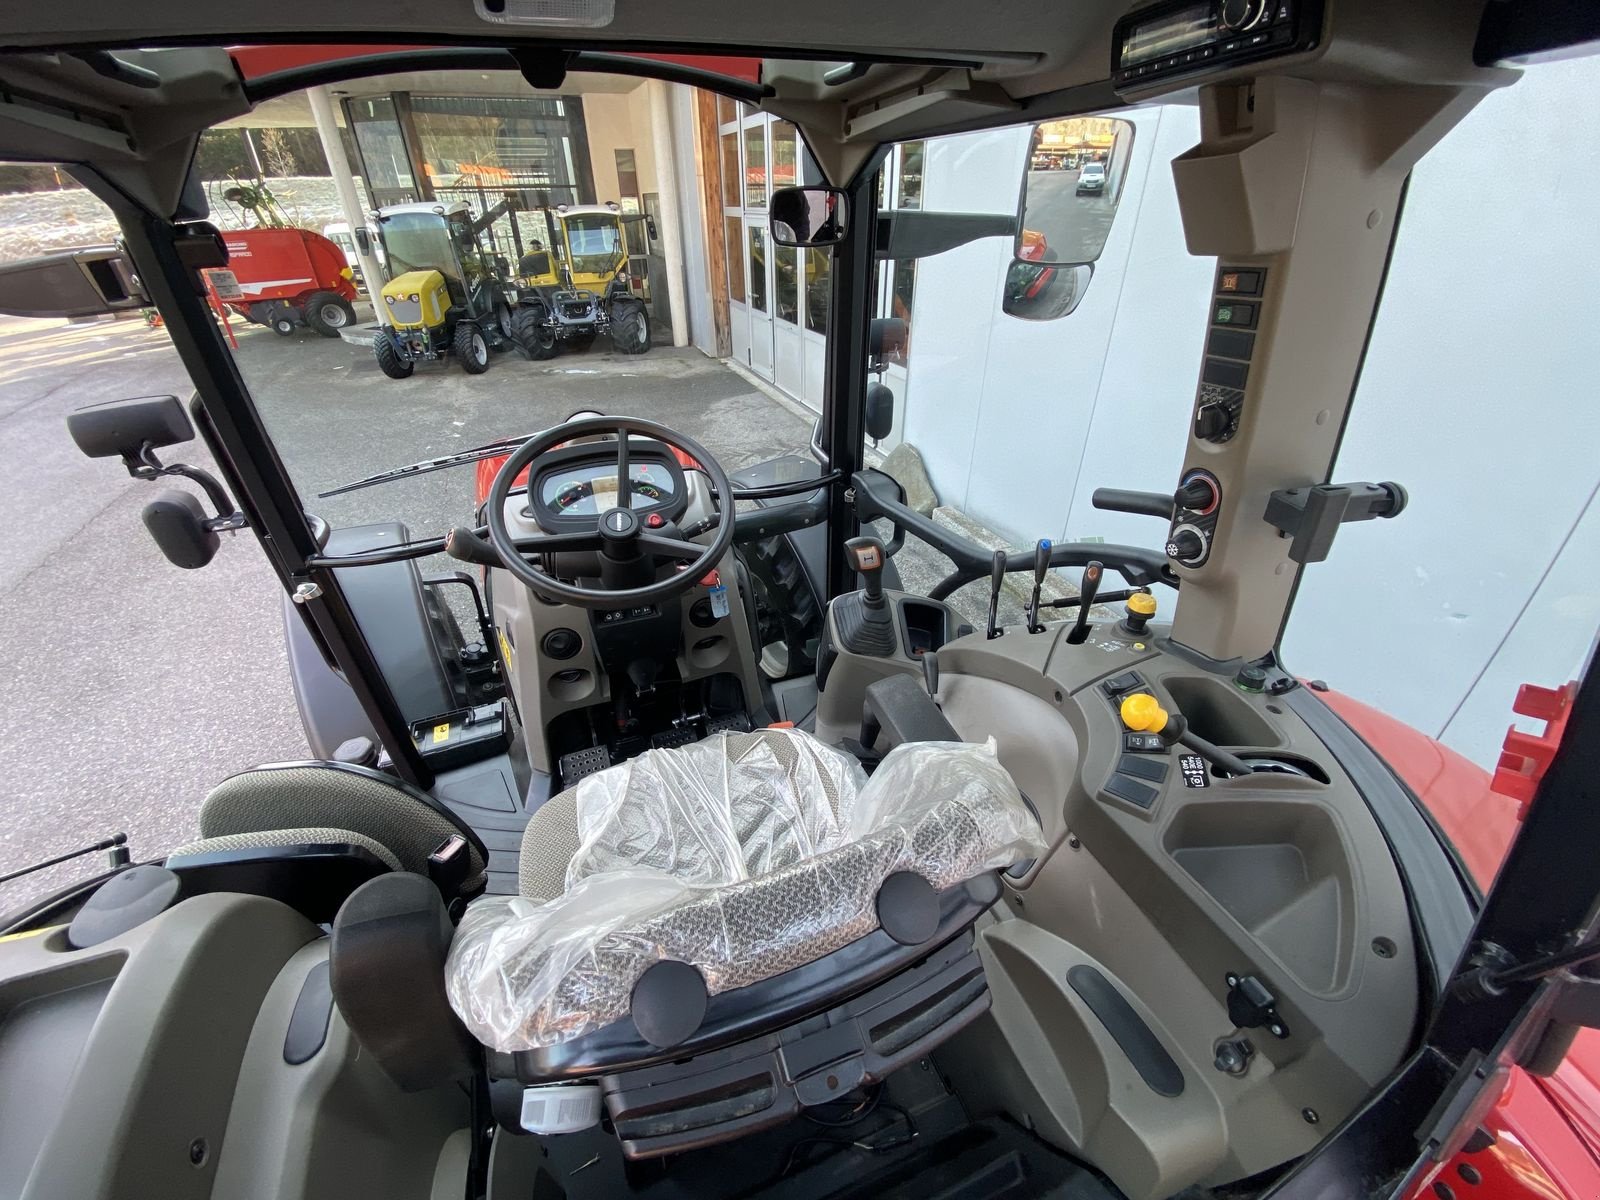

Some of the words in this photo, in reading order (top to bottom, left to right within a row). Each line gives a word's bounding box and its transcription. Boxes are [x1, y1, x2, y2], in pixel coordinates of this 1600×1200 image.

[1181, 760, 1189, 770] 540
[1187, 756, 1197, 769] 540E
[1195, 757, 1204, 769] 1000
